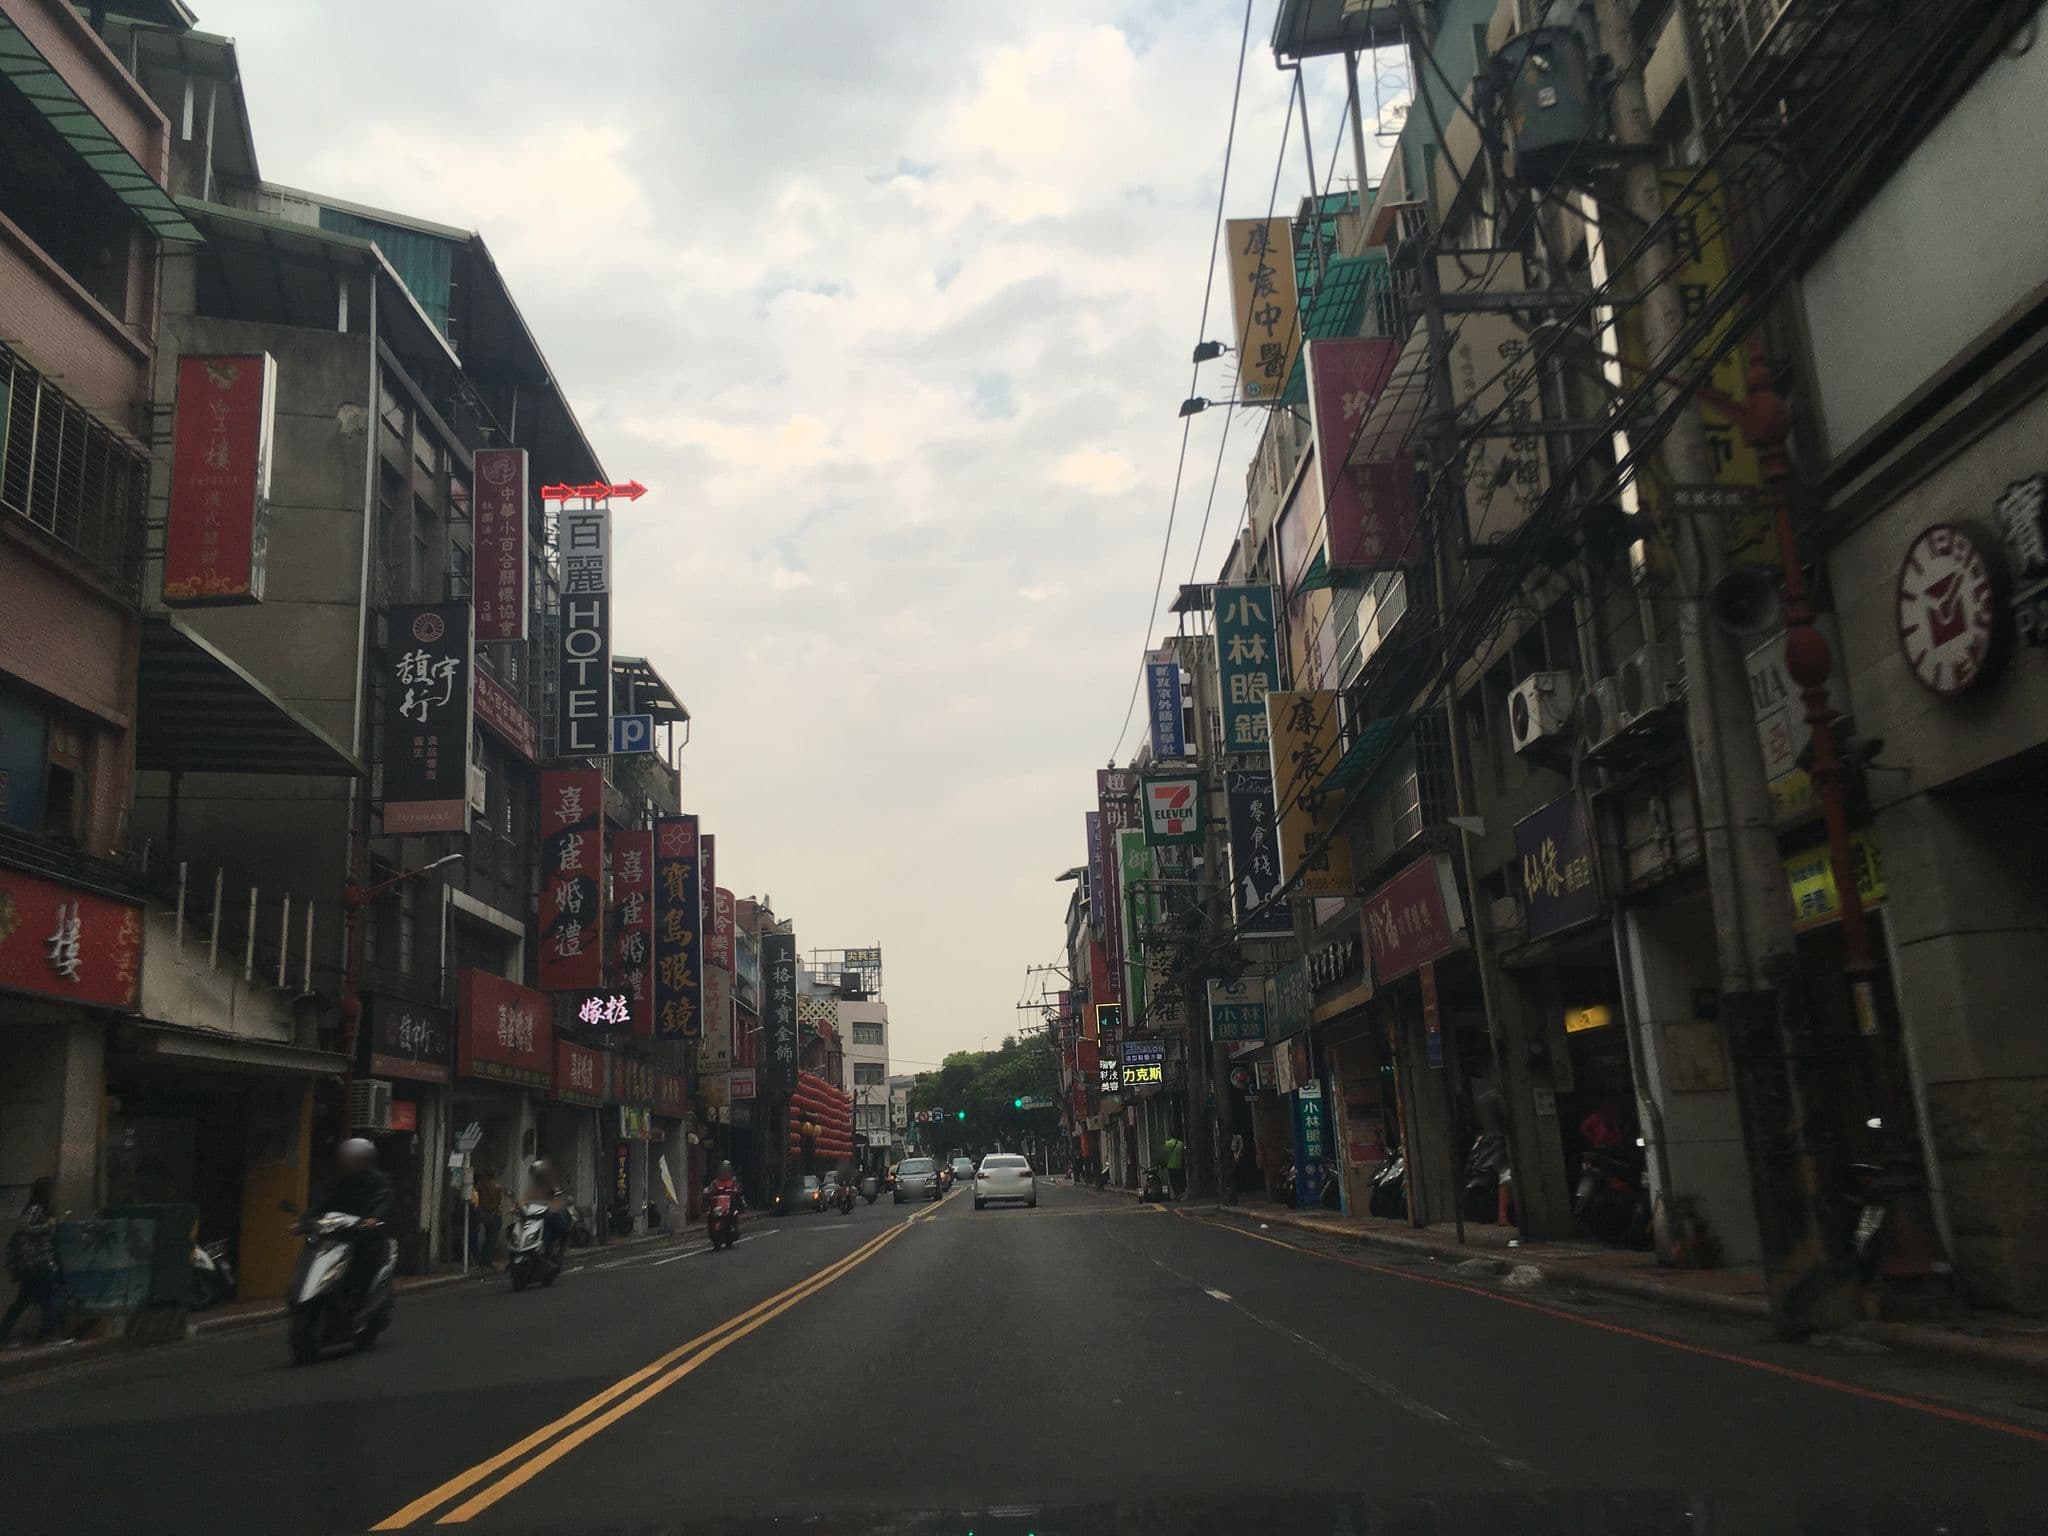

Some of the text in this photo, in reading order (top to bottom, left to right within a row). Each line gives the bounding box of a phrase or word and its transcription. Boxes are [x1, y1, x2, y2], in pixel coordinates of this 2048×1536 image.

[566, 514, 605, 593] 百麗
[564, 600, 601, 750] HOTEL
[1223, 593, 1270, 744] 小林眼鏡
[1154, 785, 1191, 833] 7
[659, 863, 698, 1035] 寶島眼鏡
[773, 948, 794, 1061] 上格珠寶金飾
[1217, 1007, 1260, 1021] 小林
[1123, 1067, 1161, 1082] 力克斯
[1303, 1102, 1321, 1156] 小林眼鏡
